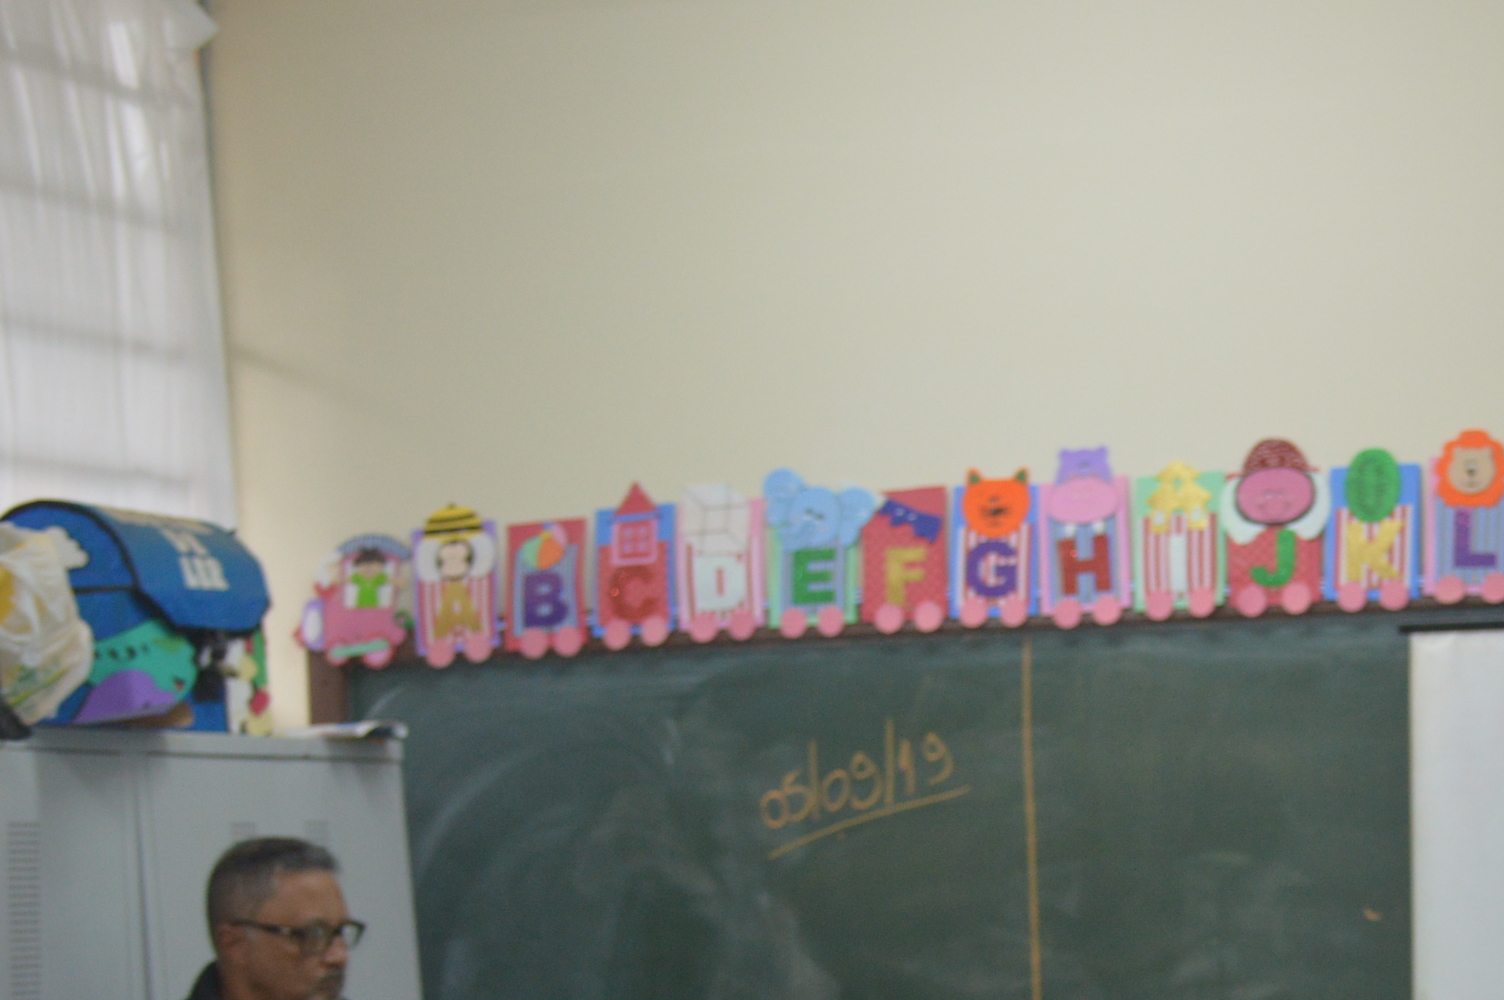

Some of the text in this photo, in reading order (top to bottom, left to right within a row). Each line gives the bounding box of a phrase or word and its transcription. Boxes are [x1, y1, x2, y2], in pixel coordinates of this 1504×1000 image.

[434, 580, 482, 639] A
[524, 572, 569, 628] B
[608, 564, 663, 622] C
[695, 554, 747, 611] D
[793, 547, 838, 603] E
[885, 547, 926, 605] F
[966, 540, 1016, 597] G
[1057, 534, 1111, 594] H
[1251, 529, 1296, 587] J
[1345, 519, 1401, 581] K
[1453, 508, 1496, 567] L
[759, 716, 956, 830] 05/09/19
